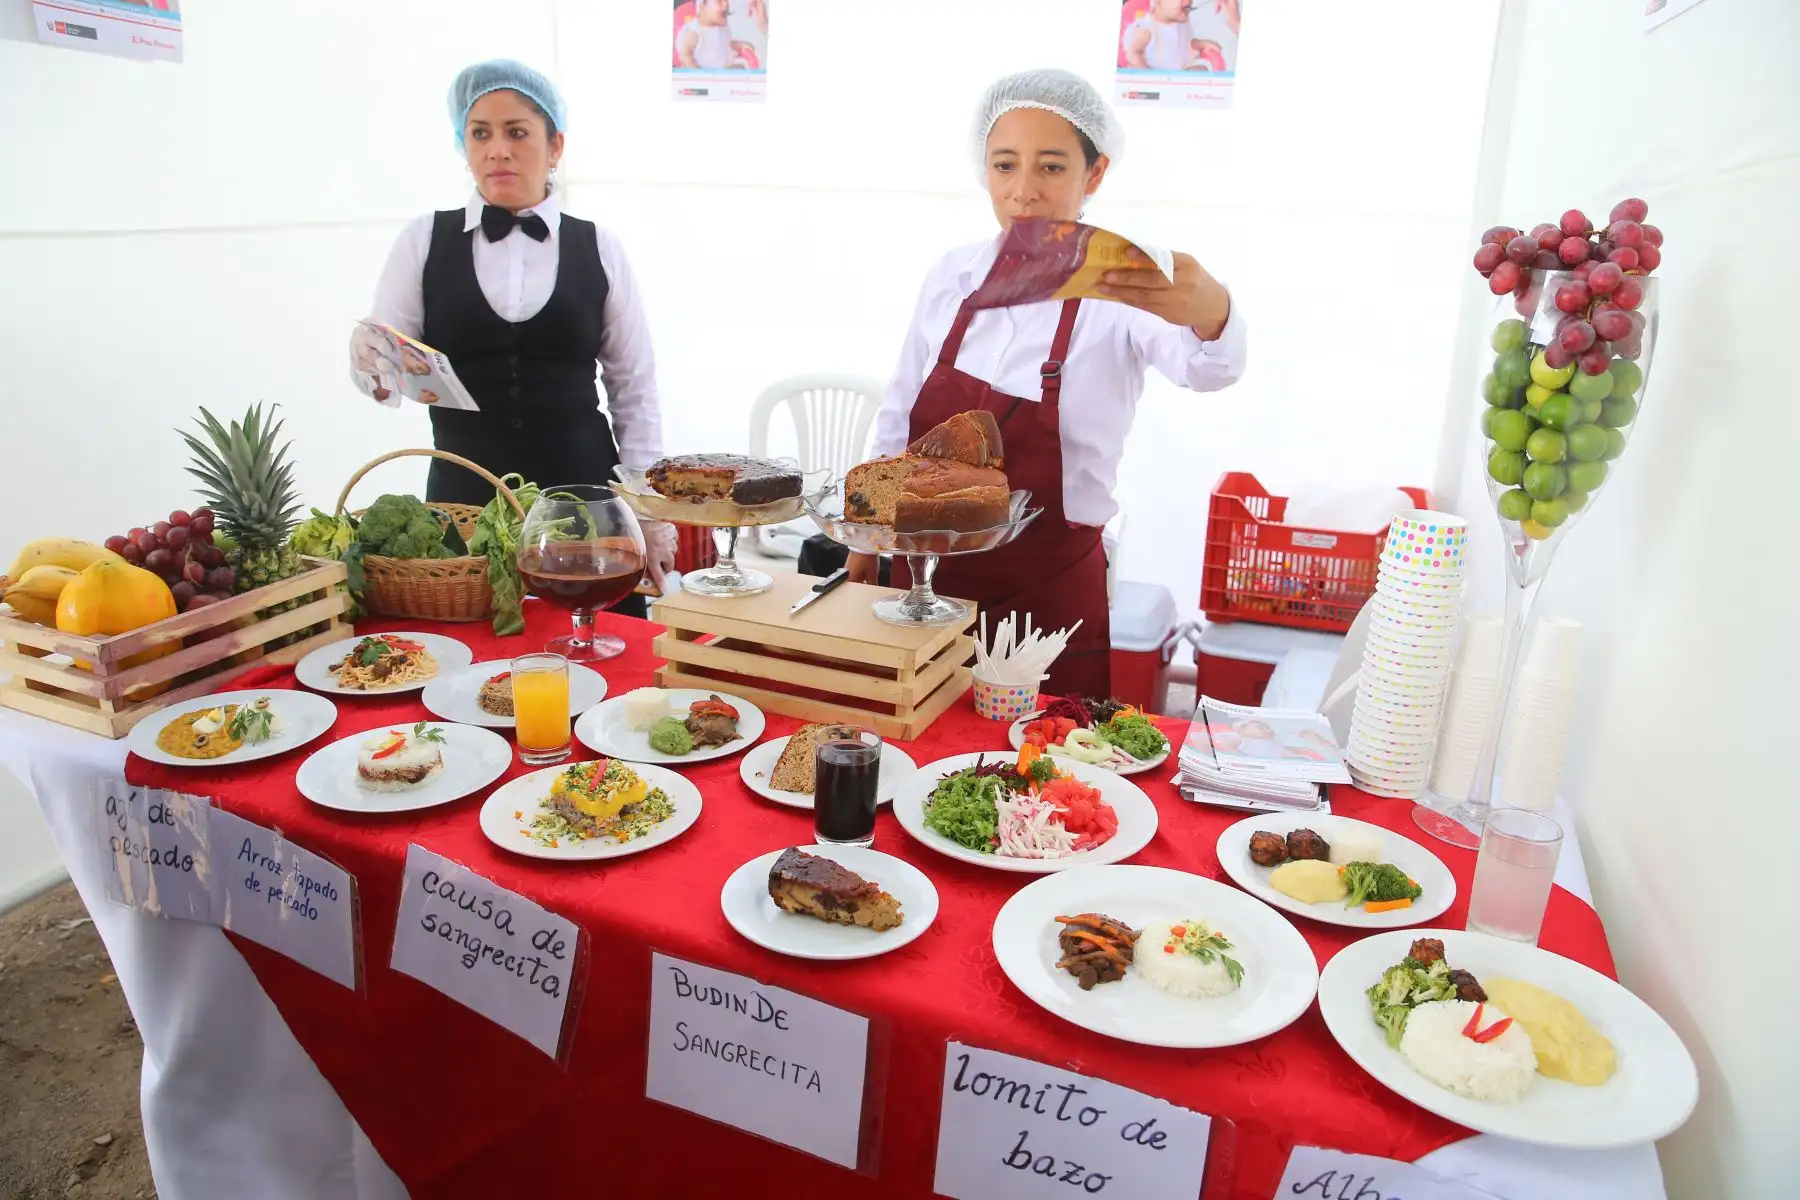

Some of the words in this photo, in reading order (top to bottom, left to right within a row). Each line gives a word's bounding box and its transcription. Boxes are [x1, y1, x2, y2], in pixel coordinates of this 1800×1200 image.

[148, 801, 176, 827] de
[109, 837, 195, 872] pescado
[238, 837, 283, 877] Arroz
[293, 862, 339, 903] tapado
[244, 871, 262, 893] de
[267, 884, 319, 921] pescado
[421, 870, 516, 937] causa
[531, 928, 566, 961] de
[420, 912, 561, 999] sangrecita
[668, 966, 748, 1015] BUDIN
[750, 990, 790, 1031] DE
[673, 1021, 822, 1093] SANGRECITA
[952, 1053, 1108, 1127] lomito
[1120, 1118, 1168, 1151] de
[1002, 1129, 1113, 1194] bazo
